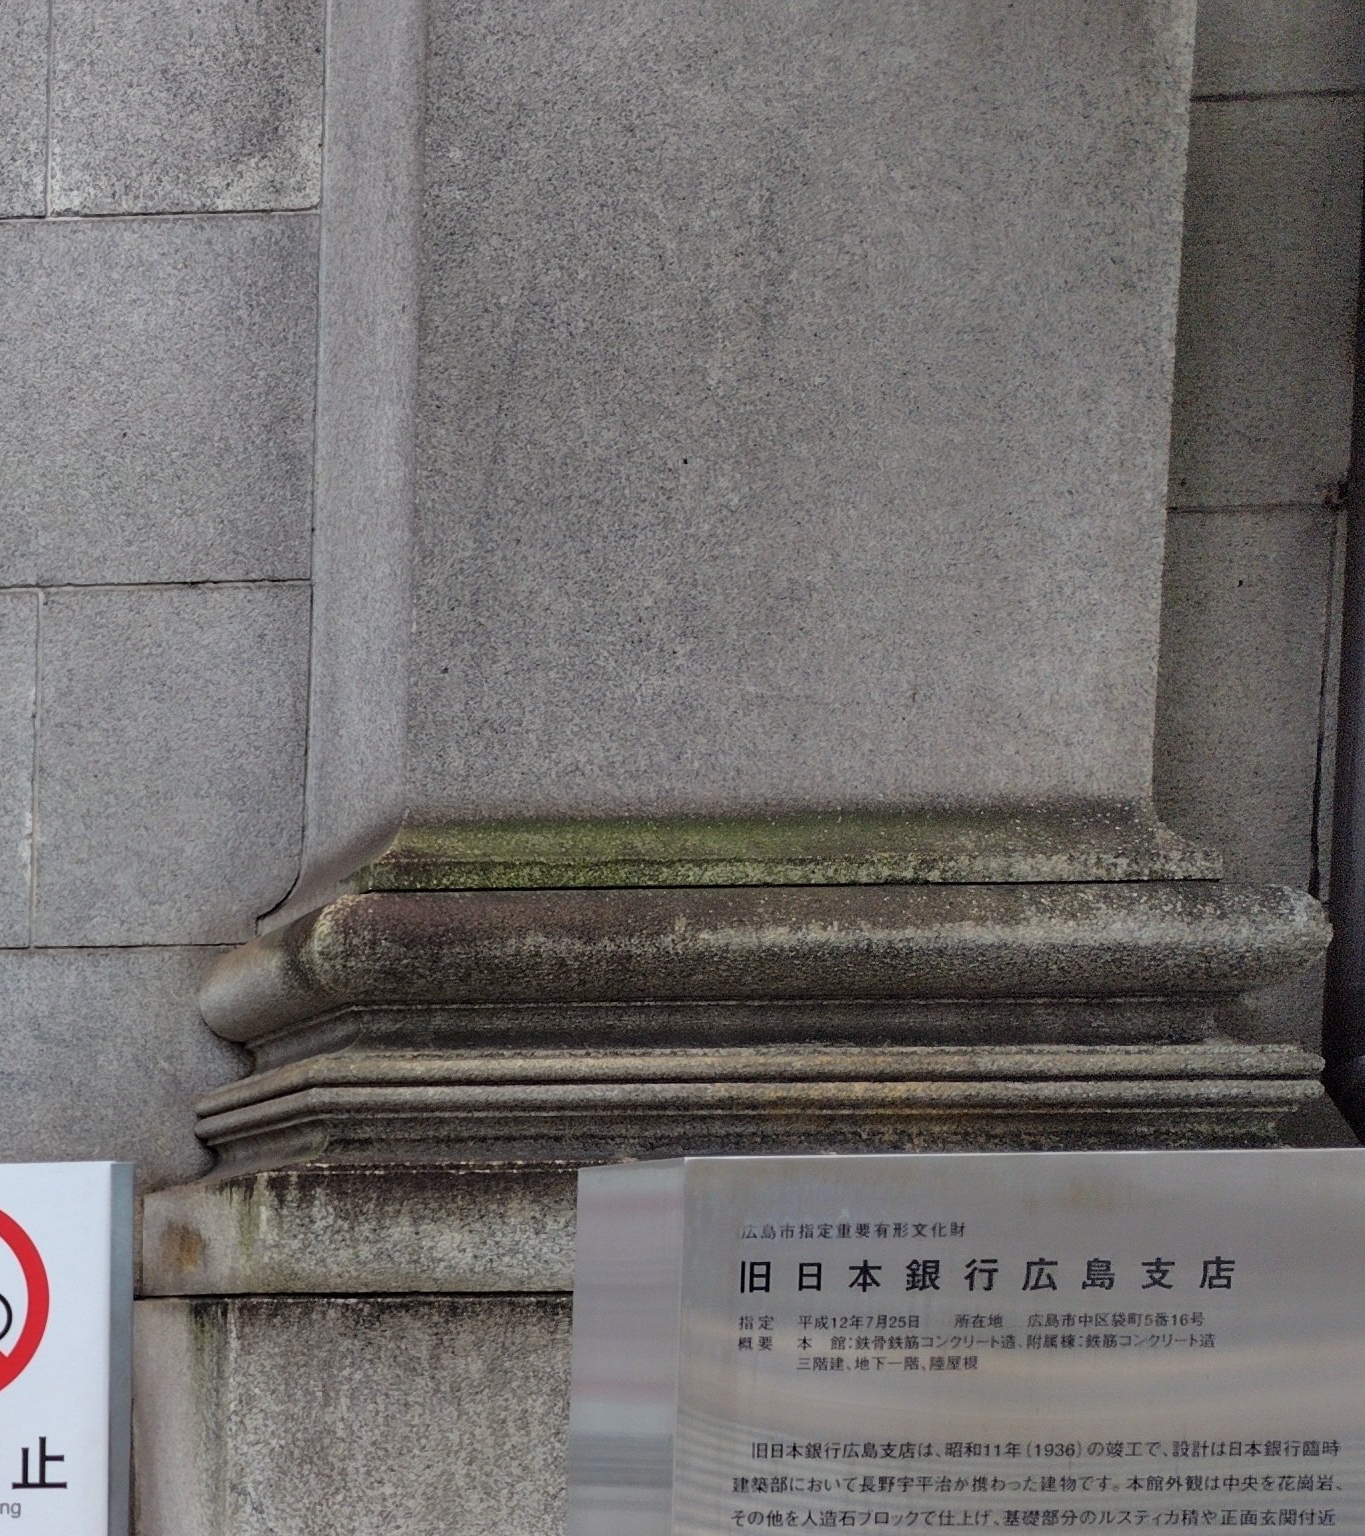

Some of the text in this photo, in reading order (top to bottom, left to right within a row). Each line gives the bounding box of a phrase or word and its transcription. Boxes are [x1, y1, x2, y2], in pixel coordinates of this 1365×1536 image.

[740, 1221, 966, 1241] 広島市指定重要有形文化財
[739, 1256, 1237, 1294] 旧日本銀行広島支店
[737, 1311, 1206, 1332] 指定 平成12年7月25日 所在地 広島市中区袋町5番16号
[737, 1335, 774, 1353] 概要
[796, 1355, 979, 1373] 三階建、地下一階、陸屋根
